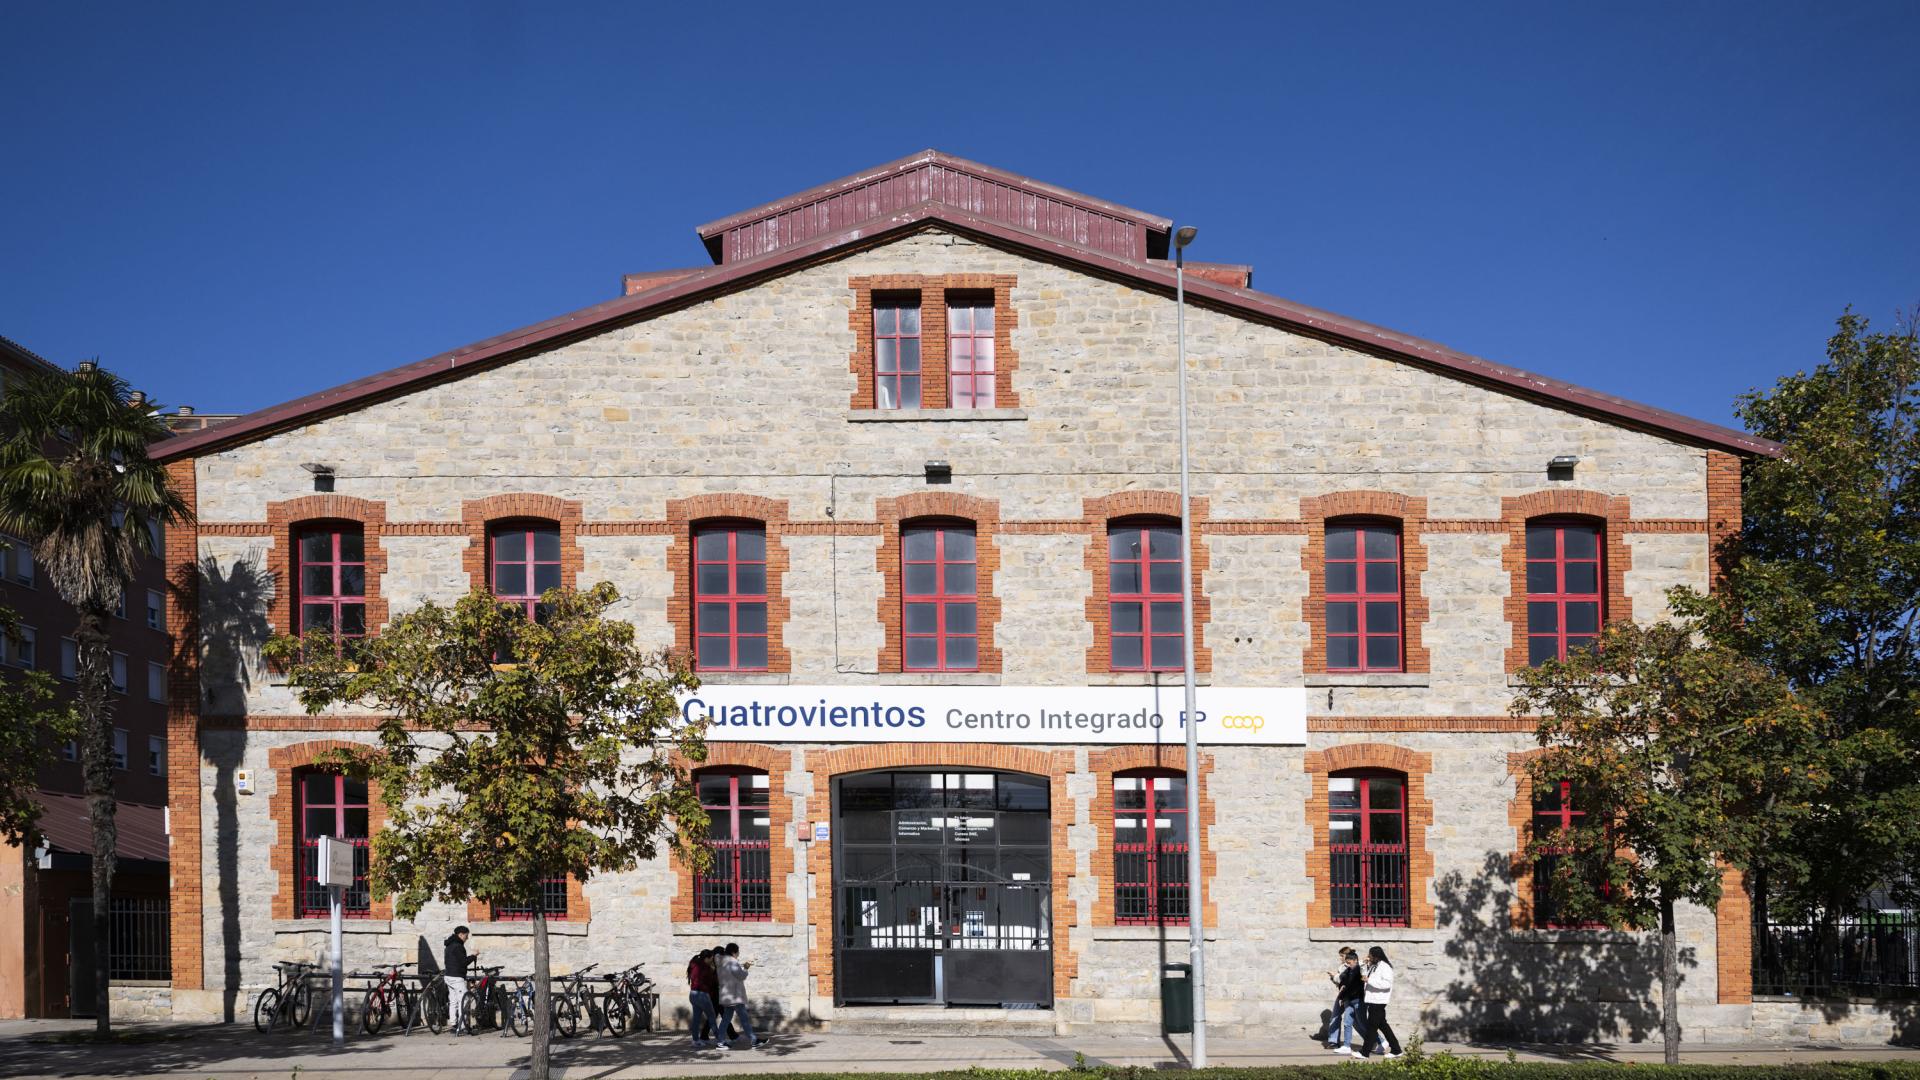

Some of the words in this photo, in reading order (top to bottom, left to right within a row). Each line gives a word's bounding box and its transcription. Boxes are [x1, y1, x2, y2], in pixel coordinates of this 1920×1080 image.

[683, 698, 926, 728] Cuatrovientos
[945, 708, 1031, 729] Centro
[1040, 707, 1164, 733] Integrado
[1222, 715, 1265, 734] coop
